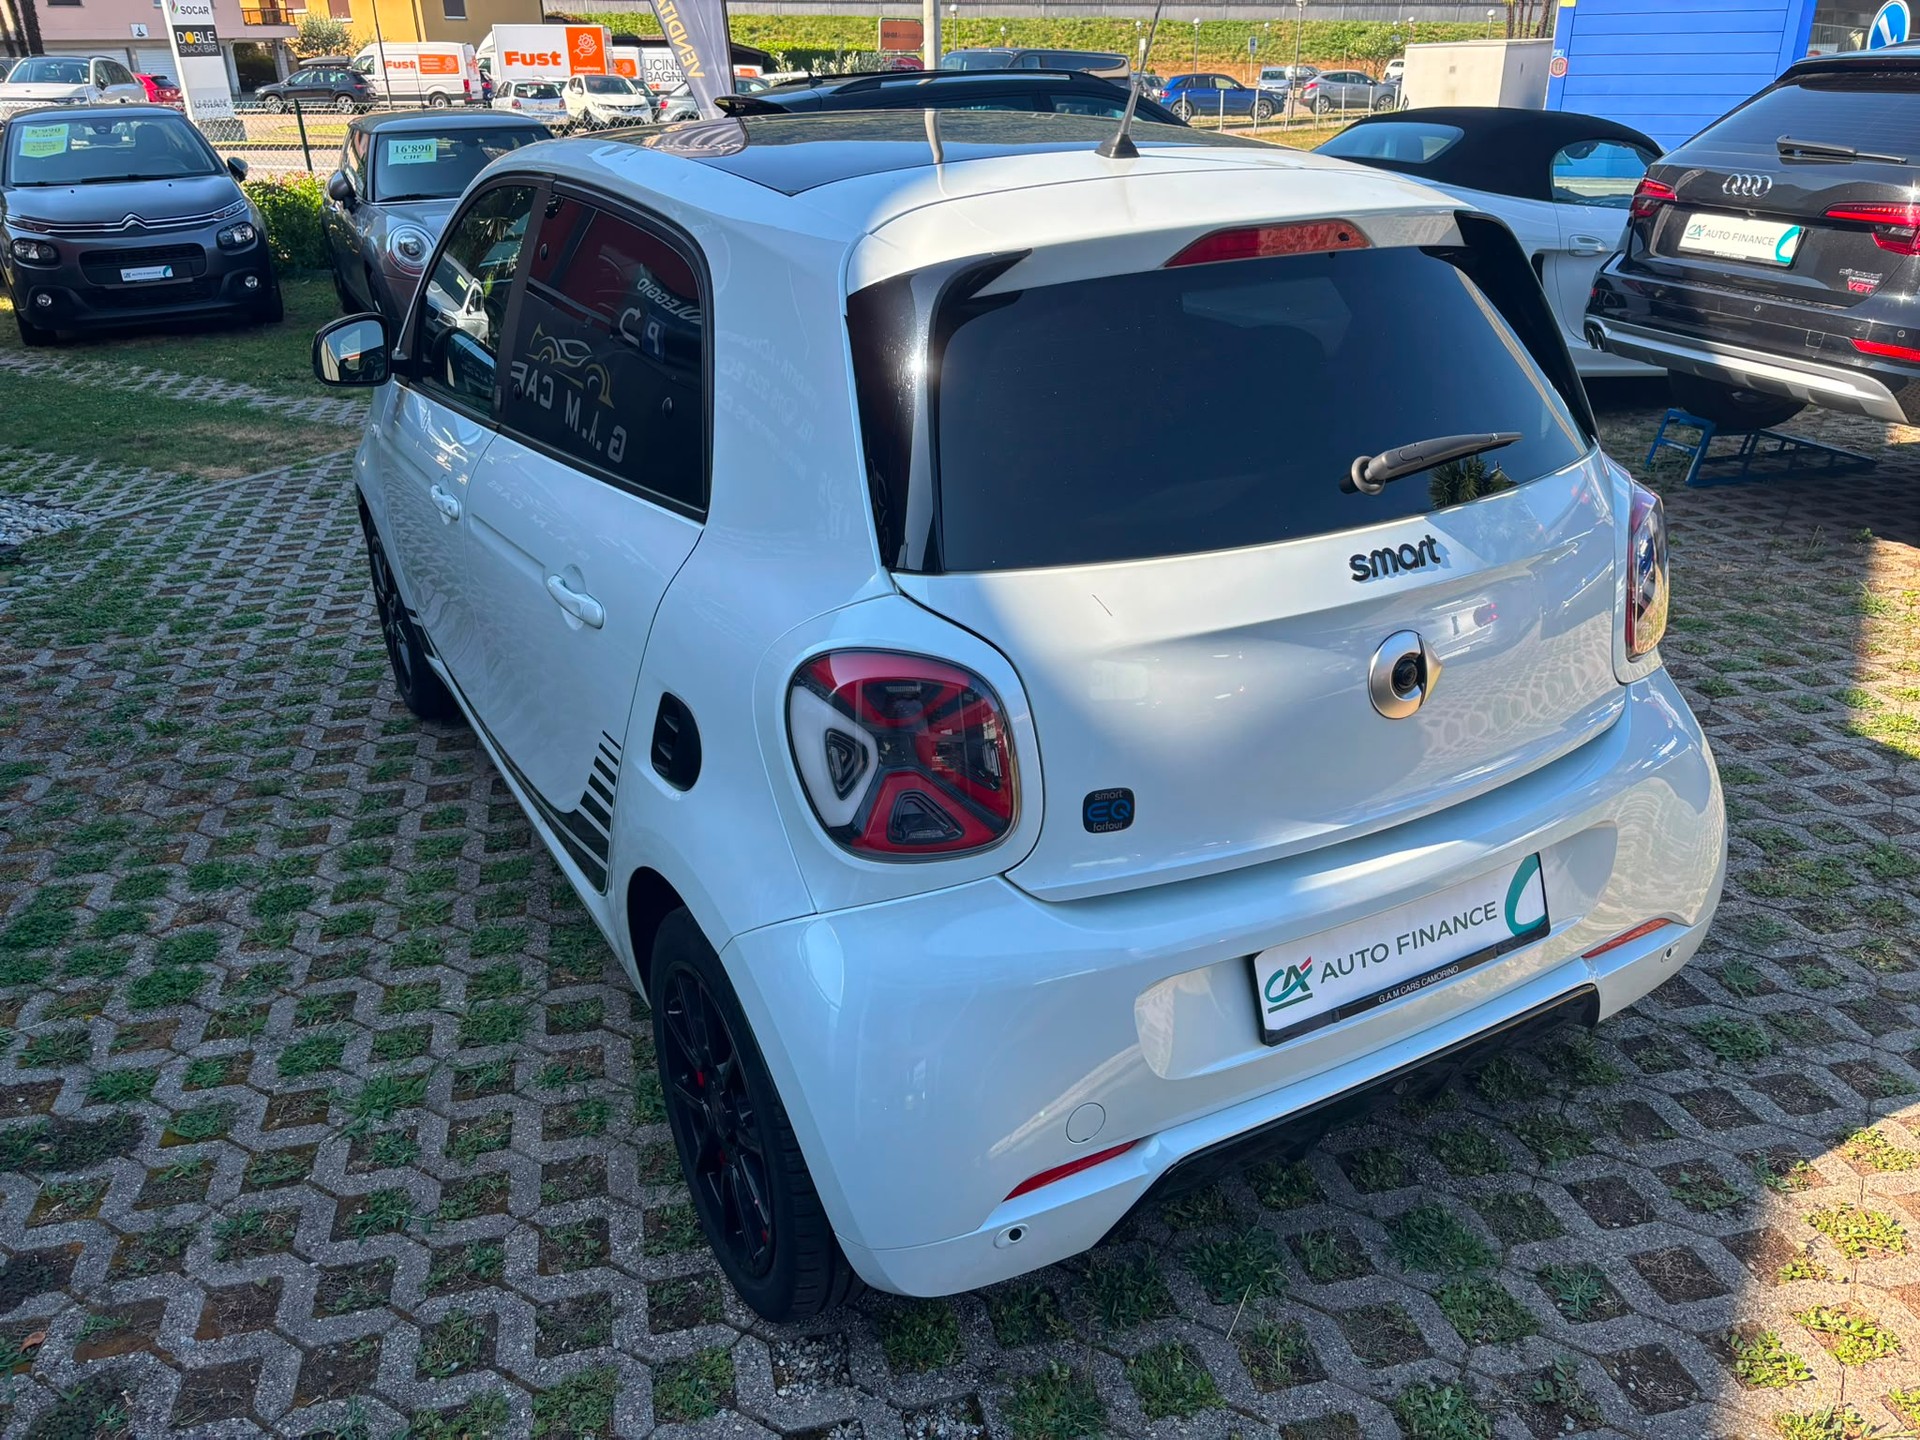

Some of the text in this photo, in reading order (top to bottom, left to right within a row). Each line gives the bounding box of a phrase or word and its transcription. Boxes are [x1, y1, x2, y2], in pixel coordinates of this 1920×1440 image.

[180, 6, 210, 15] SOCAR
[176, 31, 216, 45] DOBLE
[203, 45, 218, 53] BAR
[384, 60, 416, 69] Fust
[504, 51, 562, 66] Fust
[395, 144, 432, 153] 16'890
[1704, 229, 1731, 241] AUTO
[1731, 231, 1775, 246] FINANCE
[1349, 534, 1441, 582] smart
[1094, 790, 1124, 801] smart
[1087, 799, 1131, 822] EQ
[1093, 820, 1124, 832] forfour
[1320, 942, 1390, 984] AUTO
[1396, 900, 1498, 955] FINANCE
[1400, 980, 1421, 995] CARS
[1421, 965, 1459, 986] CAMORINO
